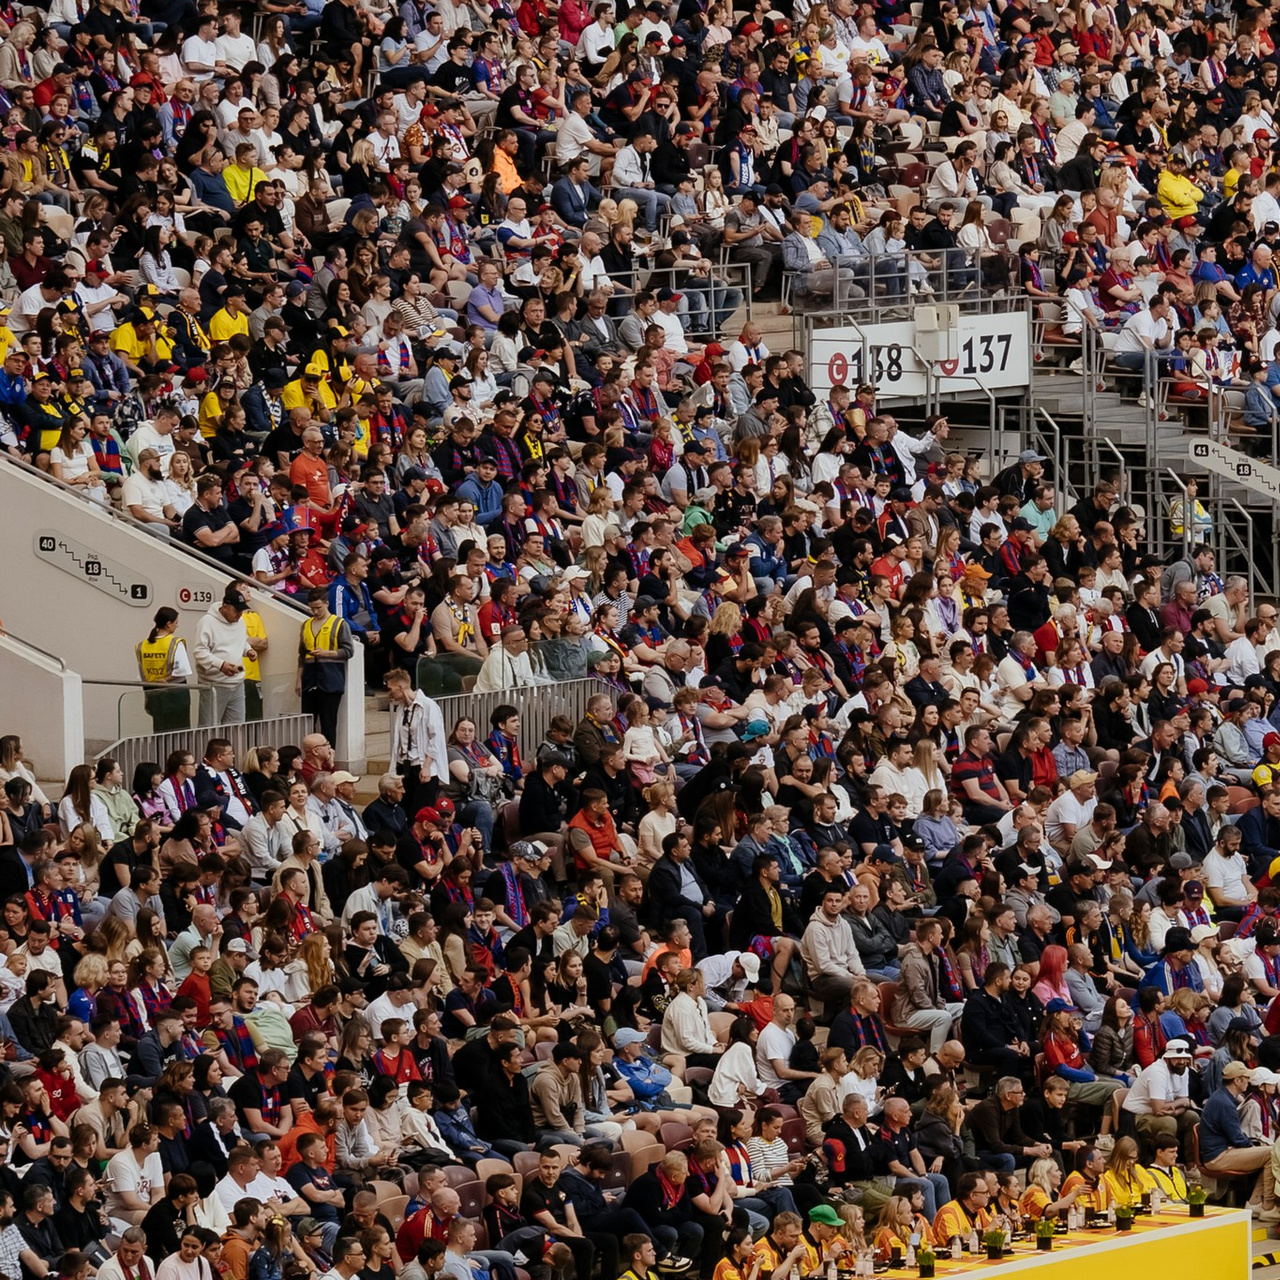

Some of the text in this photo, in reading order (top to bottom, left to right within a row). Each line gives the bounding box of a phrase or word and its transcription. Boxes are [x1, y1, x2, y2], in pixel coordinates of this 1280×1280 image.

[962, 334, 1012, 375] 137
[1195, 446, 1208, 456] 41
[1239, 465, 1249, 475] 18
[42, 538, 54, 550] 40
[88, 564, 99, 575] 18
[194, 591, 212, 602] 139
